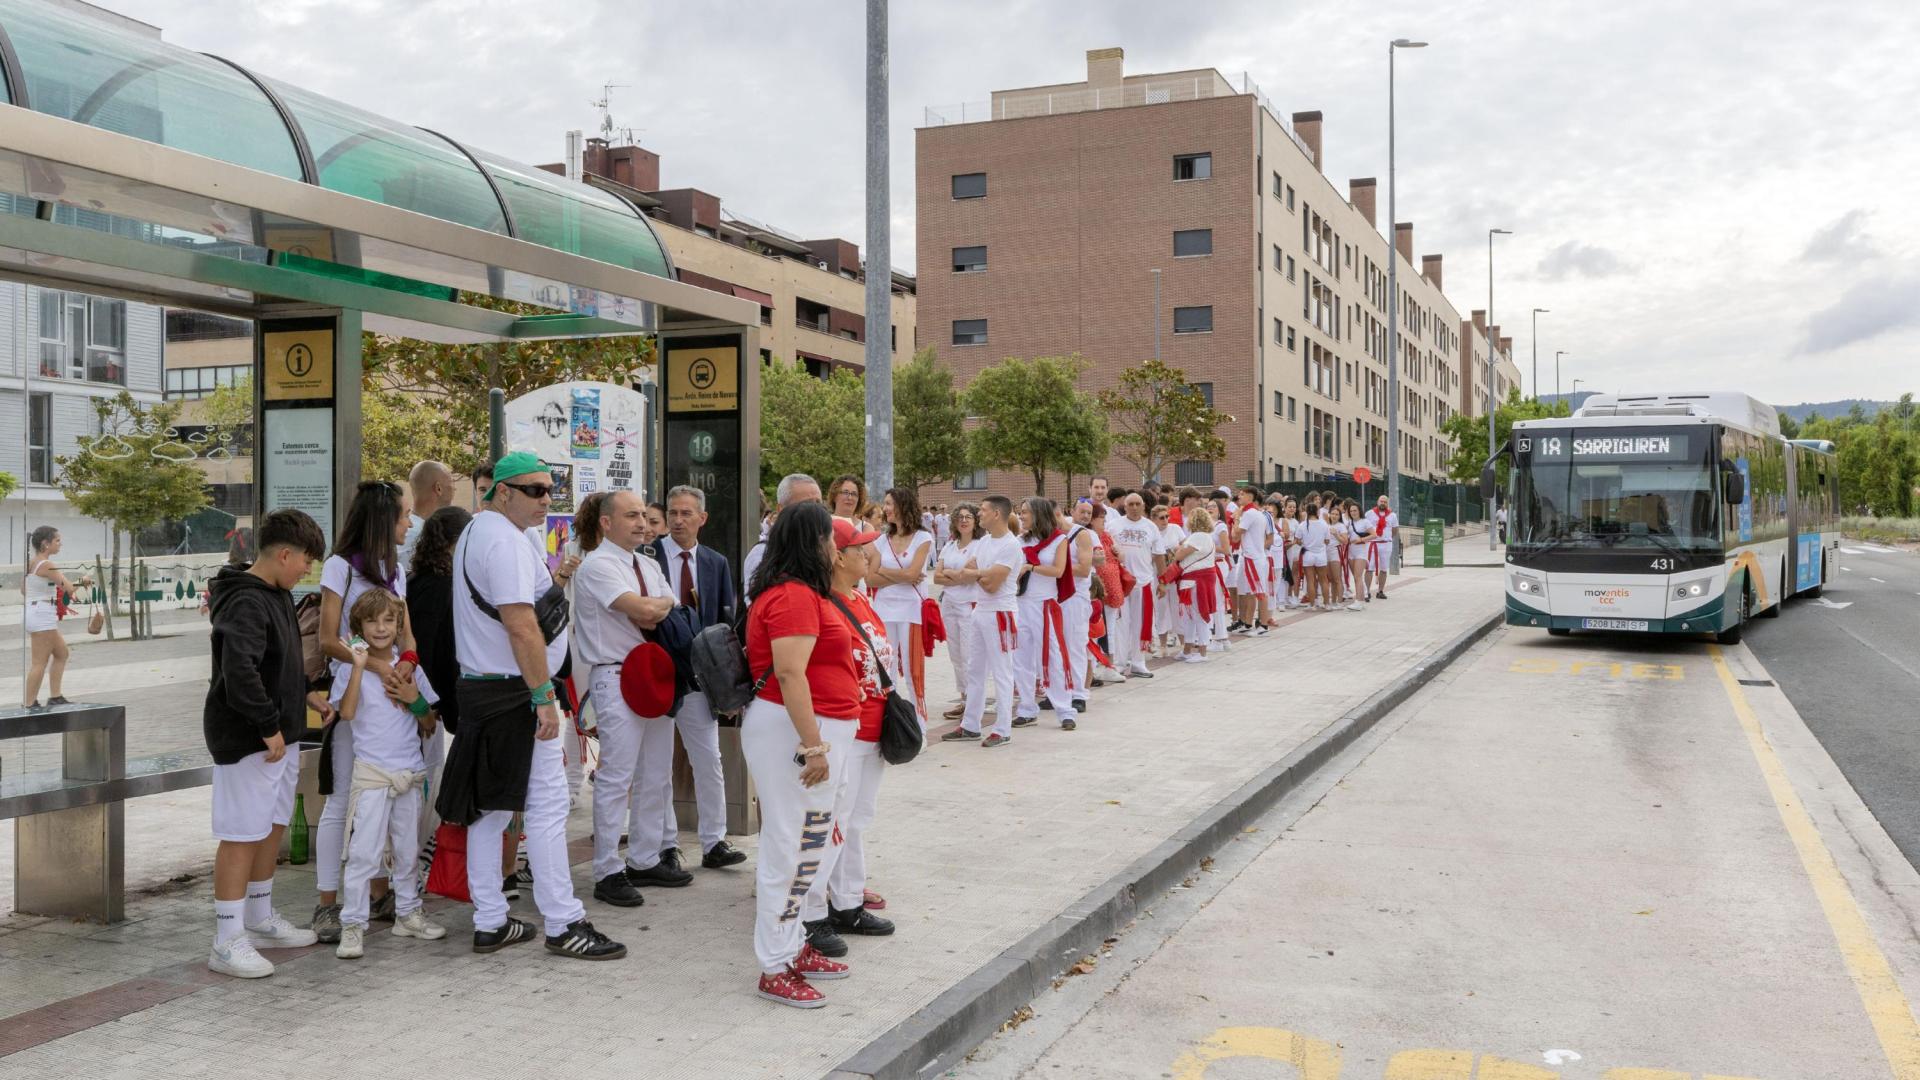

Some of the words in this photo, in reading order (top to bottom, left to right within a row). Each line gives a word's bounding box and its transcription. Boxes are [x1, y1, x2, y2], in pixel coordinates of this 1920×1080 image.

[693, 435, 713, 457] 18
[1541, 437, 1561, 455] 18
[1573, 437, 1670, 455] SARRIGUREN
[690, 472, 715, 490] N10
[1650, 558, 1674, 570] 431
[1584, 587, 1630, 597] moventis
[1587, 619, 1608, 628] 5208
